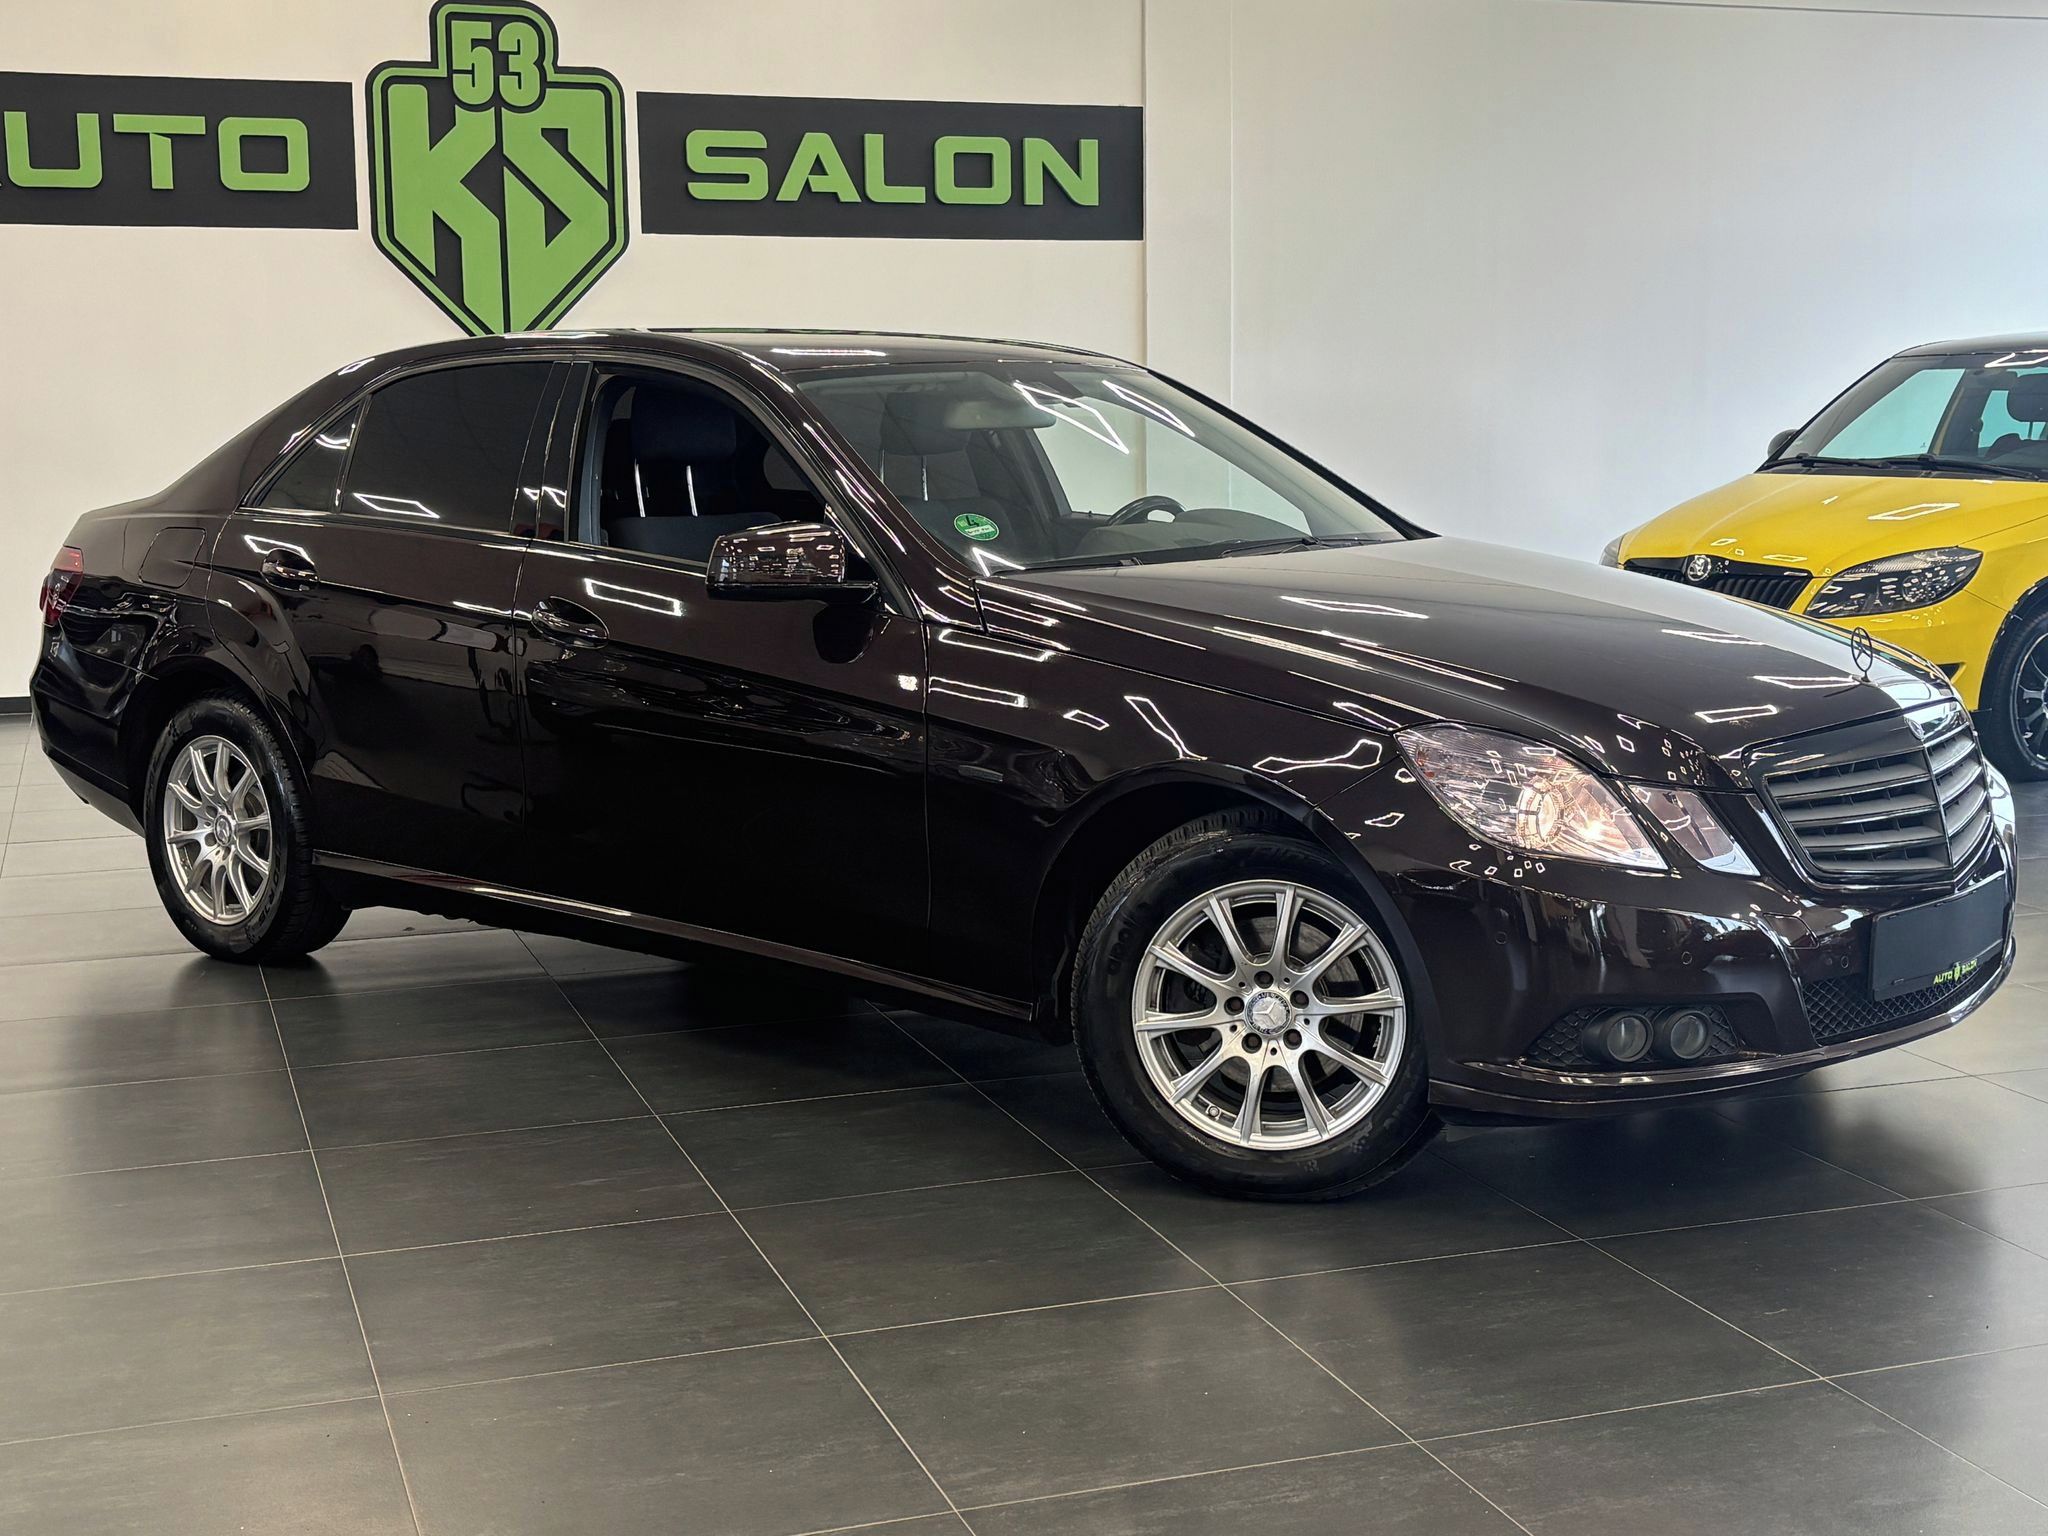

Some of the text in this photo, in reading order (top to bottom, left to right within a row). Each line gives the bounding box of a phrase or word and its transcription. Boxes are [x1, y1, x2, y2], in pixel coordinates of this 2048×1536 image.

[451, 19, 542, 107] 53
[0, 111, 310, 192] UTO
[685, 129, 1099, 206] SALON
[1933, 970, 1953, 985] AUTO
